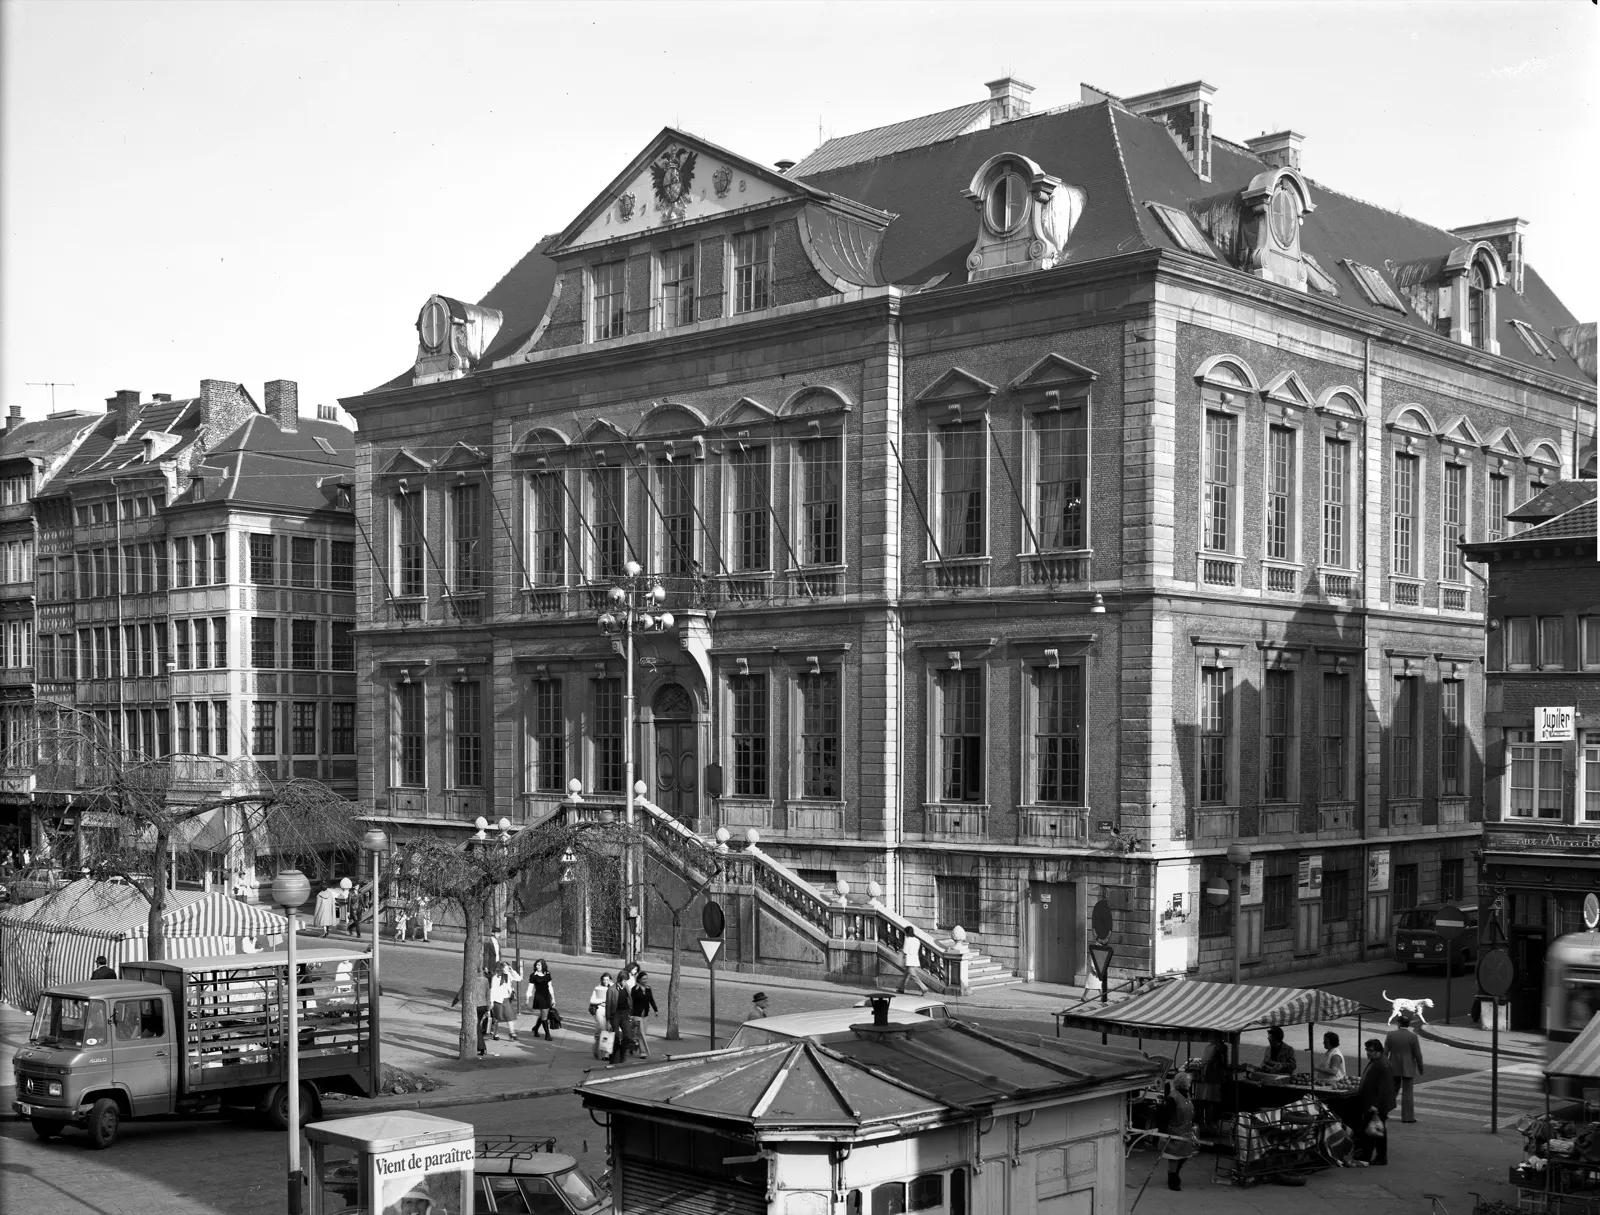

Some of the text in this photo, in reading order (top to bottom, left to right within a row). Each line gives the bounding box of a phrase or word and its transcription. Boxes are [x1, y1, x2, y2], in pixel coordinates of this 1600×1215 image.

[1542, 708, 1570, 733] Jupiler
[376, 1147, 474, 1176] Vient de paraître.
